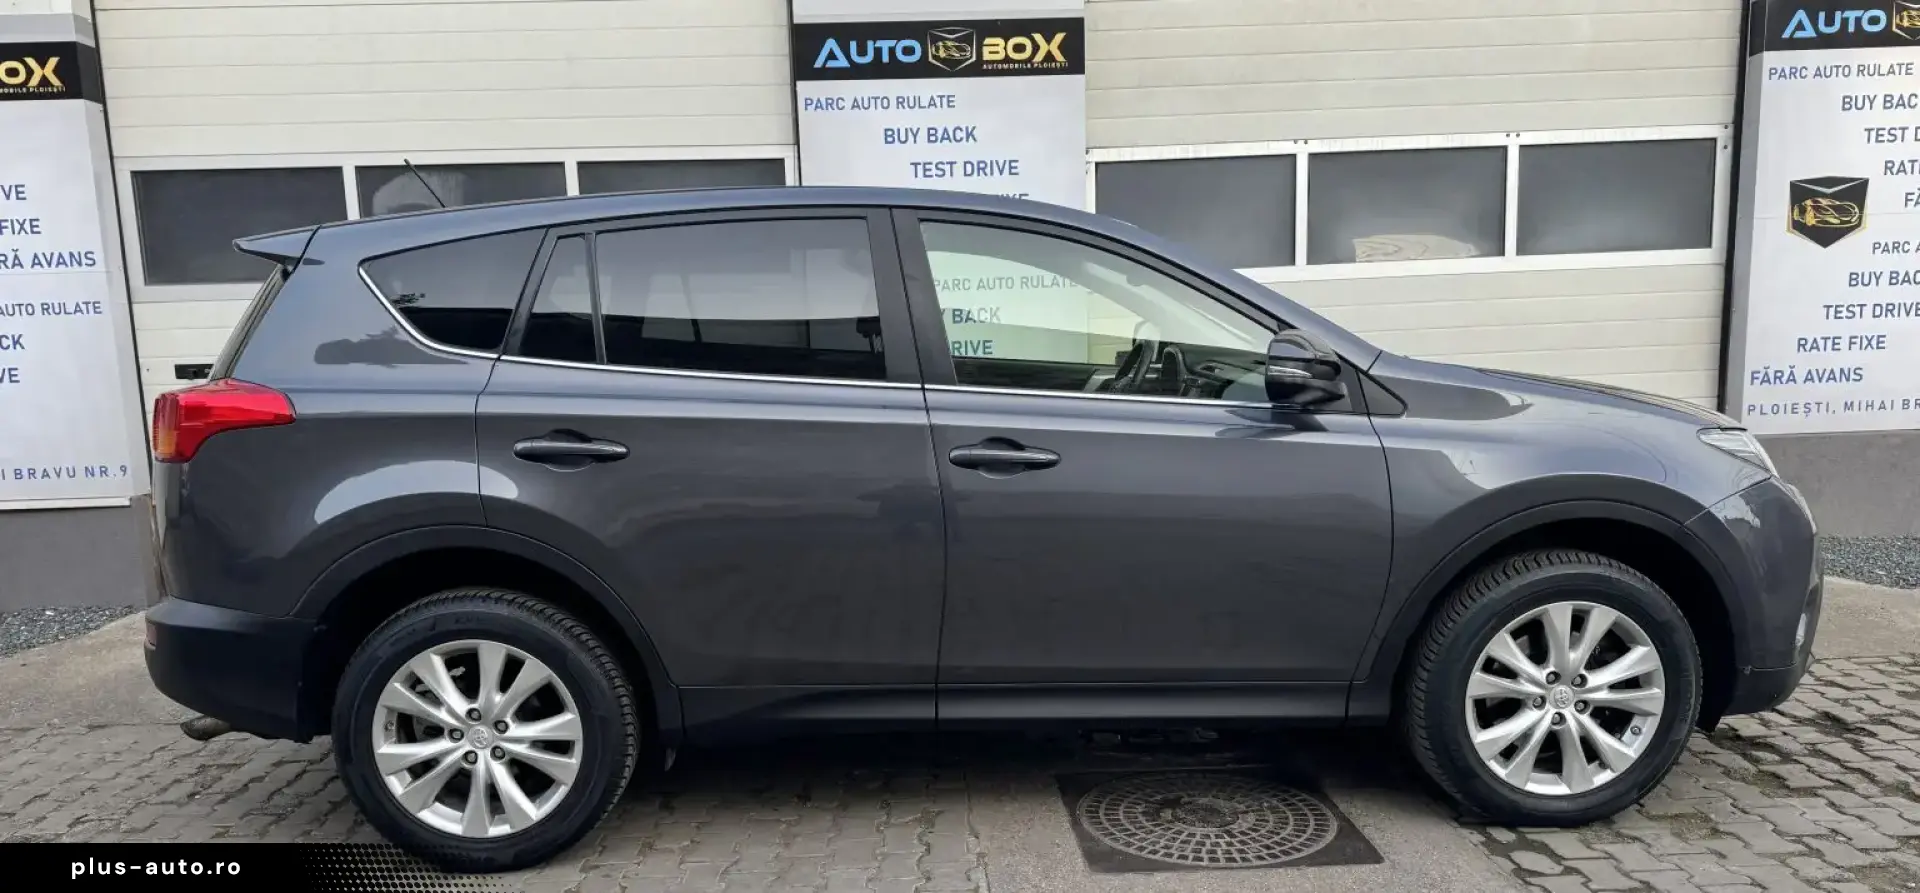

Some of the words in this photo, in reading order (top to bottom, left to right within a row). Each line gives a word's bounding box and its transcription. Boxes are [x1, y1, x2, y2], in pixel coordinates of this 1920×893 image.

[1781, 9, 1888, 39] AUTO
[813, 37, 922, 68] AUTO
[982, 32, 1067, 62] BOX
[1768, 66, 1808, 80] PARC
[1813, 64, 1851, 79] AUTO
[1856, 62, 1914, 77] RULATE
[804, 97, 846, 111] PARC
[850, 96, 891, 110] AUTO
[896, 94, 956, 109] RULATE
[1841, 94, 1877, 111] BUY
[1882, 93, 1918, 110] BAC
[884, 128, 920, 145] BUY
[927, 126, 977, 143] BACK
[1864, 126, 1909, 144] TEST
[910, 161, 957, 178] TEST
[963, 159, 1019, 177] DRIVE
[1883, 159, 1920, 176] RAT
[0, 218, 42, 235] FIXE
[1872, 241, 1910, 254] PARC
[31, 251, 96, 269] AVANS
[977, 276, 1015, 290] AUTO
[1849, 271, 1883, 287] BUY
[41, 301, 103, 316] RULATE
[952, 307, 1001, 324] BACK
[1823, 303, 1867, 320] TEST
[1797, 336, 1842, 353] RATE
[1848, 335, 1886, 351] FIXE
[1750, 365, 1797, 386] FĂRĂ
[1803, 367, 1864, 383] AVANS
[1843, 399, 1894, 412] MIHAI
[14, 466, 76, 480] BRAVU
